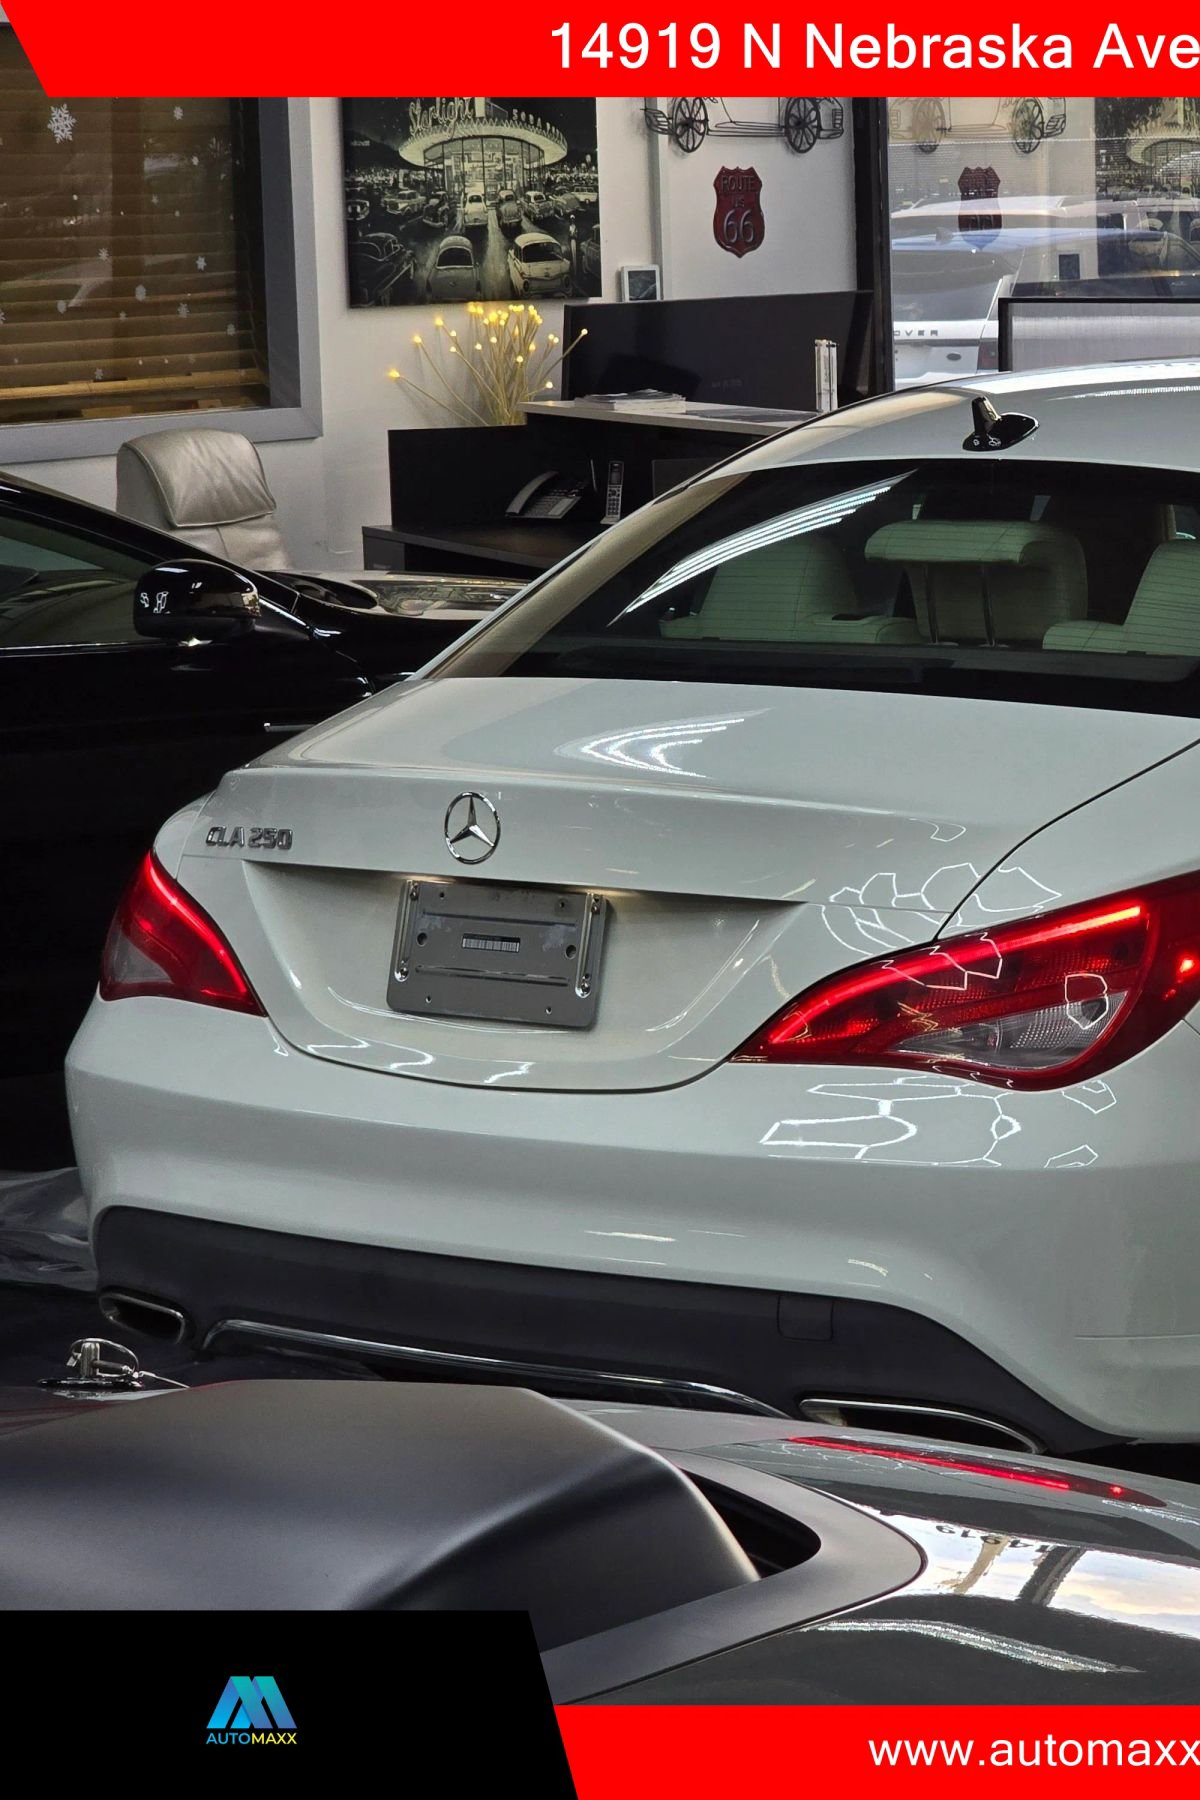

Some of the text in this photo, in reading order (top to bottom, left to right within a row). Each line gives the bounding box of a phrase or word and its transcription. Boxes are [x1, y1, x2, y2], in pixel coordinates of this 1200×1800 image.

[721, 175, 759, 193] ROUTE
[724, 209, 754, 243] 66
[206, 827, 293, 850] CLA 250
